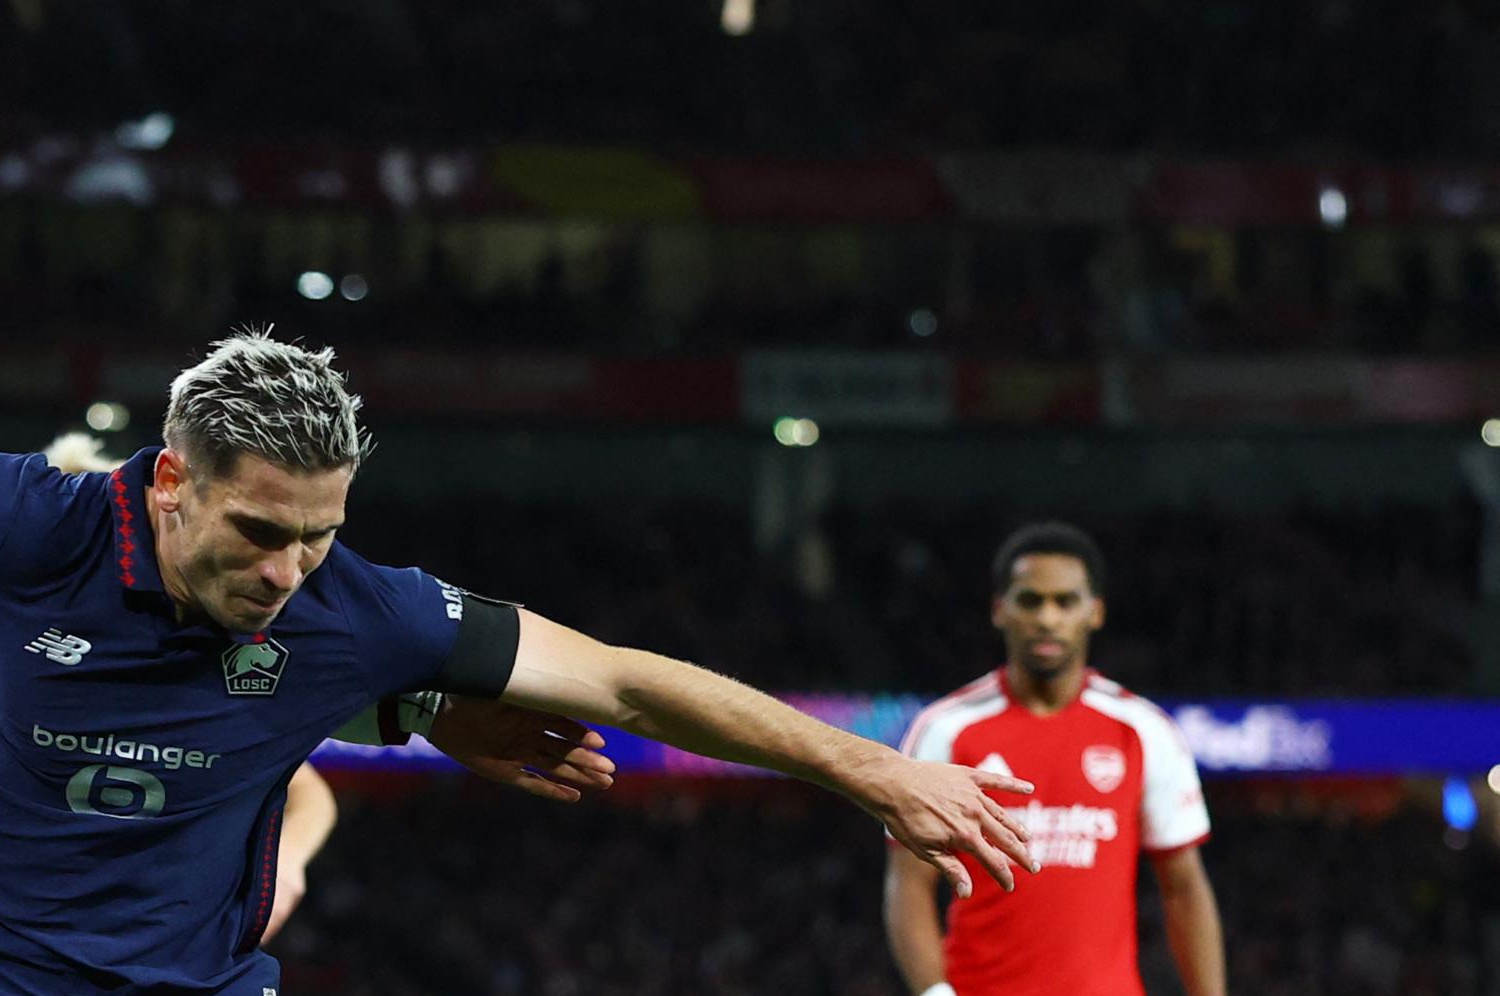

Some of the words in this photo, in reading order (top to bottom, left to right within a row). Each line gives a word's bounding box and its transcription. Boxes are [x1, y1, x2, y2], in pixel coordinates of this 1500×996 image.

[233, 678, 270, 690] LOSC
[32, 724, 222, 770] boulanger
[998, 798, 1119, 842] mirates
